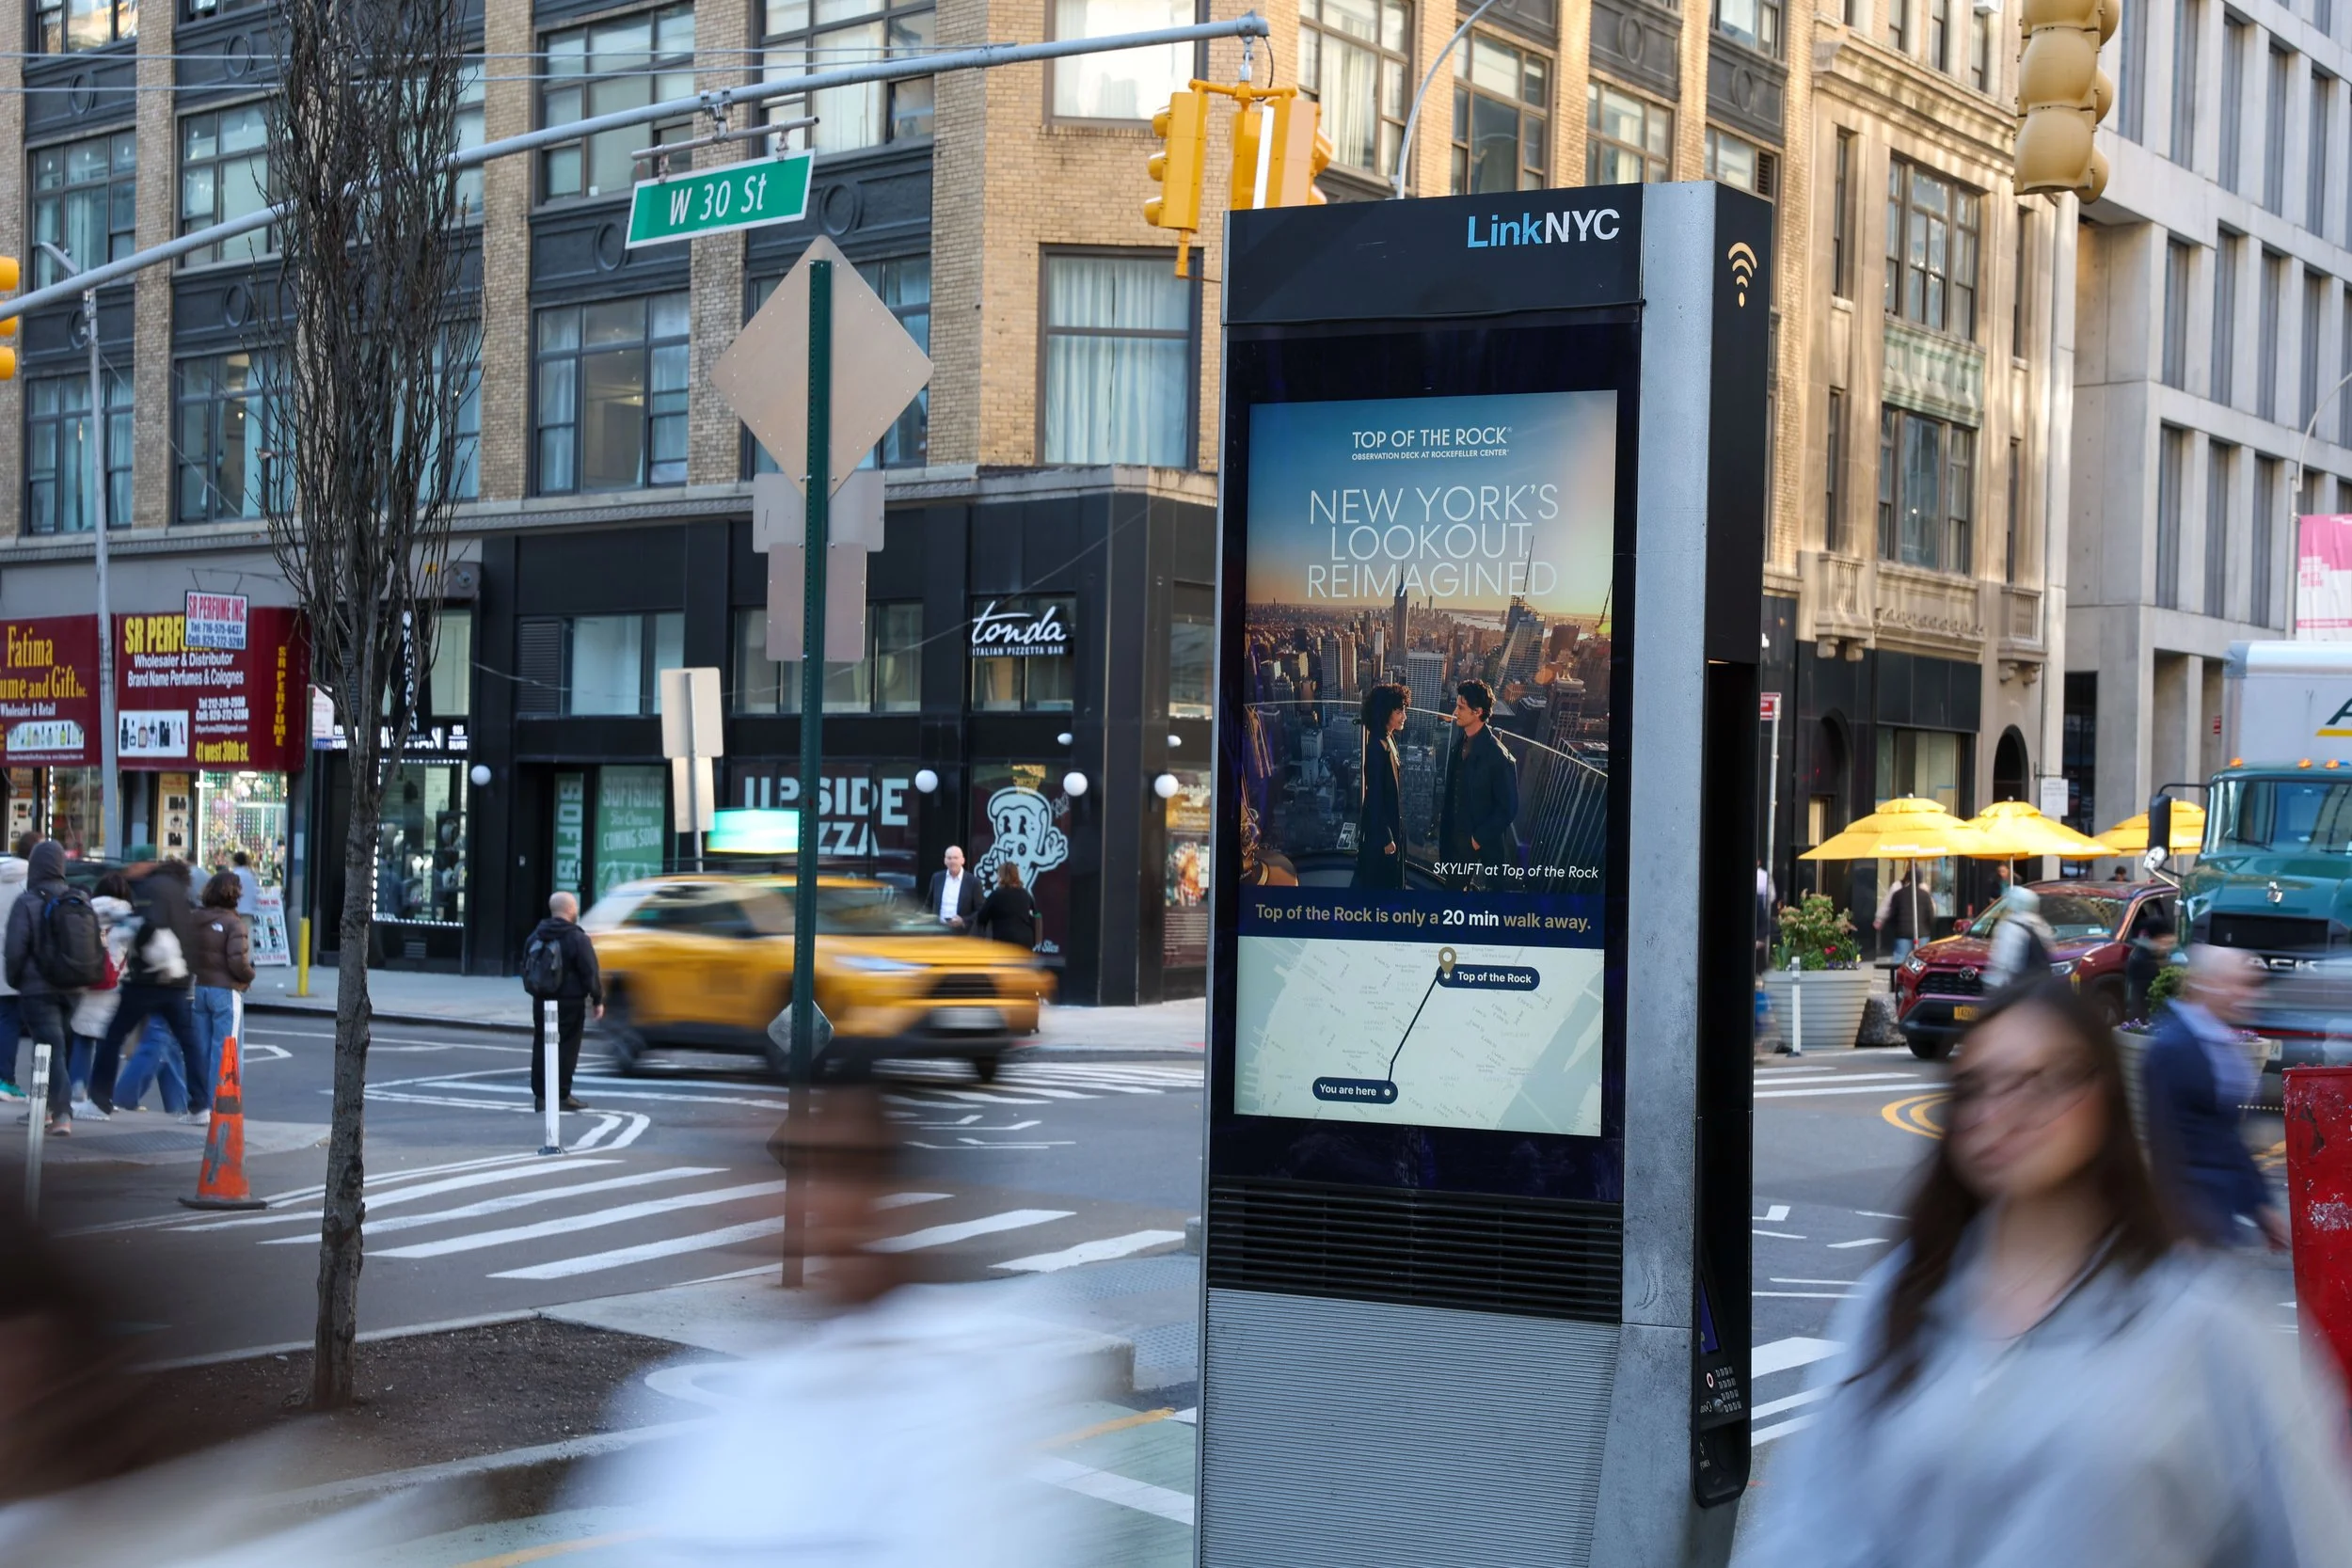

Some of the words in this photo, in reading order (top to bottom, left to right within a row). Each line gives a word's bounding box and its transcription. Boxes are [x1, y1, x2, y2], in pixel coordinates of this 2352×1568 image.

[669, 187, 692, 227] W
[699, 180, 731, 221] 30
[739, 172, 768, 214] St
[1467, 208, 1621, 248] LinkNYC
[1352, 431, 1387, 449] TOP
[1391, 430, 1415, 448] OF
[1420, 429, 1451, 447] THE
[1352, 452, 1400, 461] OBSERVATION
[1431, 450, 1478, 458] ROCKEFELLER
[1311, 487, 1404, 524] NEW
[1415, 483, 1559, 522] YORK'S
[1331, 522, 1533, 561] LOOKOUT,
[1308, 561, 1558, 598] REIMAGINED
[199, 595, 230, 621] PERFUME
[972, 600, 1067, 644] tonda
[7, 626, 53, 667] Fatima
[125, 617, 144, 654] SR
[973, 646, 1004, 657] ITALIAN
[1007, 645, 1044, 656] PIZZETTA
[1047, 645, 1064, 655] BAR
[135, 654, 179, 668] Wholesaler
[181, 653, 187, 667] &
[189, 652, 233, 667] Distributor
[29, 673, 49, 698] and
[52, 665, 75, 698] Gift
[128, 670, 148, 687] Brand
[150, 670, 169, 687] Name
[170, 669, 202, 687] Perfumes
[204, 668, 209, 685] &
[211, 668, 244, 689] Colognes
[745, 777, 910, 826] UPSIDE
[1433, 863, 1482, 876] SKYLIFT
[1485, 864, 1499, 876] at
[1502, 864, 1524, 879] Top
[1527, 864, 1542, 878] of
[1544, 865, 1565, 878] the
[1568, 865, 1599, 879] Rock
[1255, 904, 1283, 922] Top
[1286, 905, 1303, 920] of
[1305, 906, 1330, 921] the
[1334, 907, 1373, 923] Rock
[1375, 908, 1389, 923] is
[1391, 909, 1425, 927] only
[1429, 913, 1438, 925] a
[1442, 910, 1465, 926] 20
[1469, 911, 1500, 927] min
[1502, 912, 1541, 928] walk
[1544, 917, 1591, 933] away.
[1457, 972, 1476, 983] Top
[1477, 973, 1488, 981] of
[1489, 973, 1505, 982] the
[1507, 974, 1532, 983] Rock
[1319, 1084, 1337, 1094] You
[1356, 1085, 1377, 1096] here
